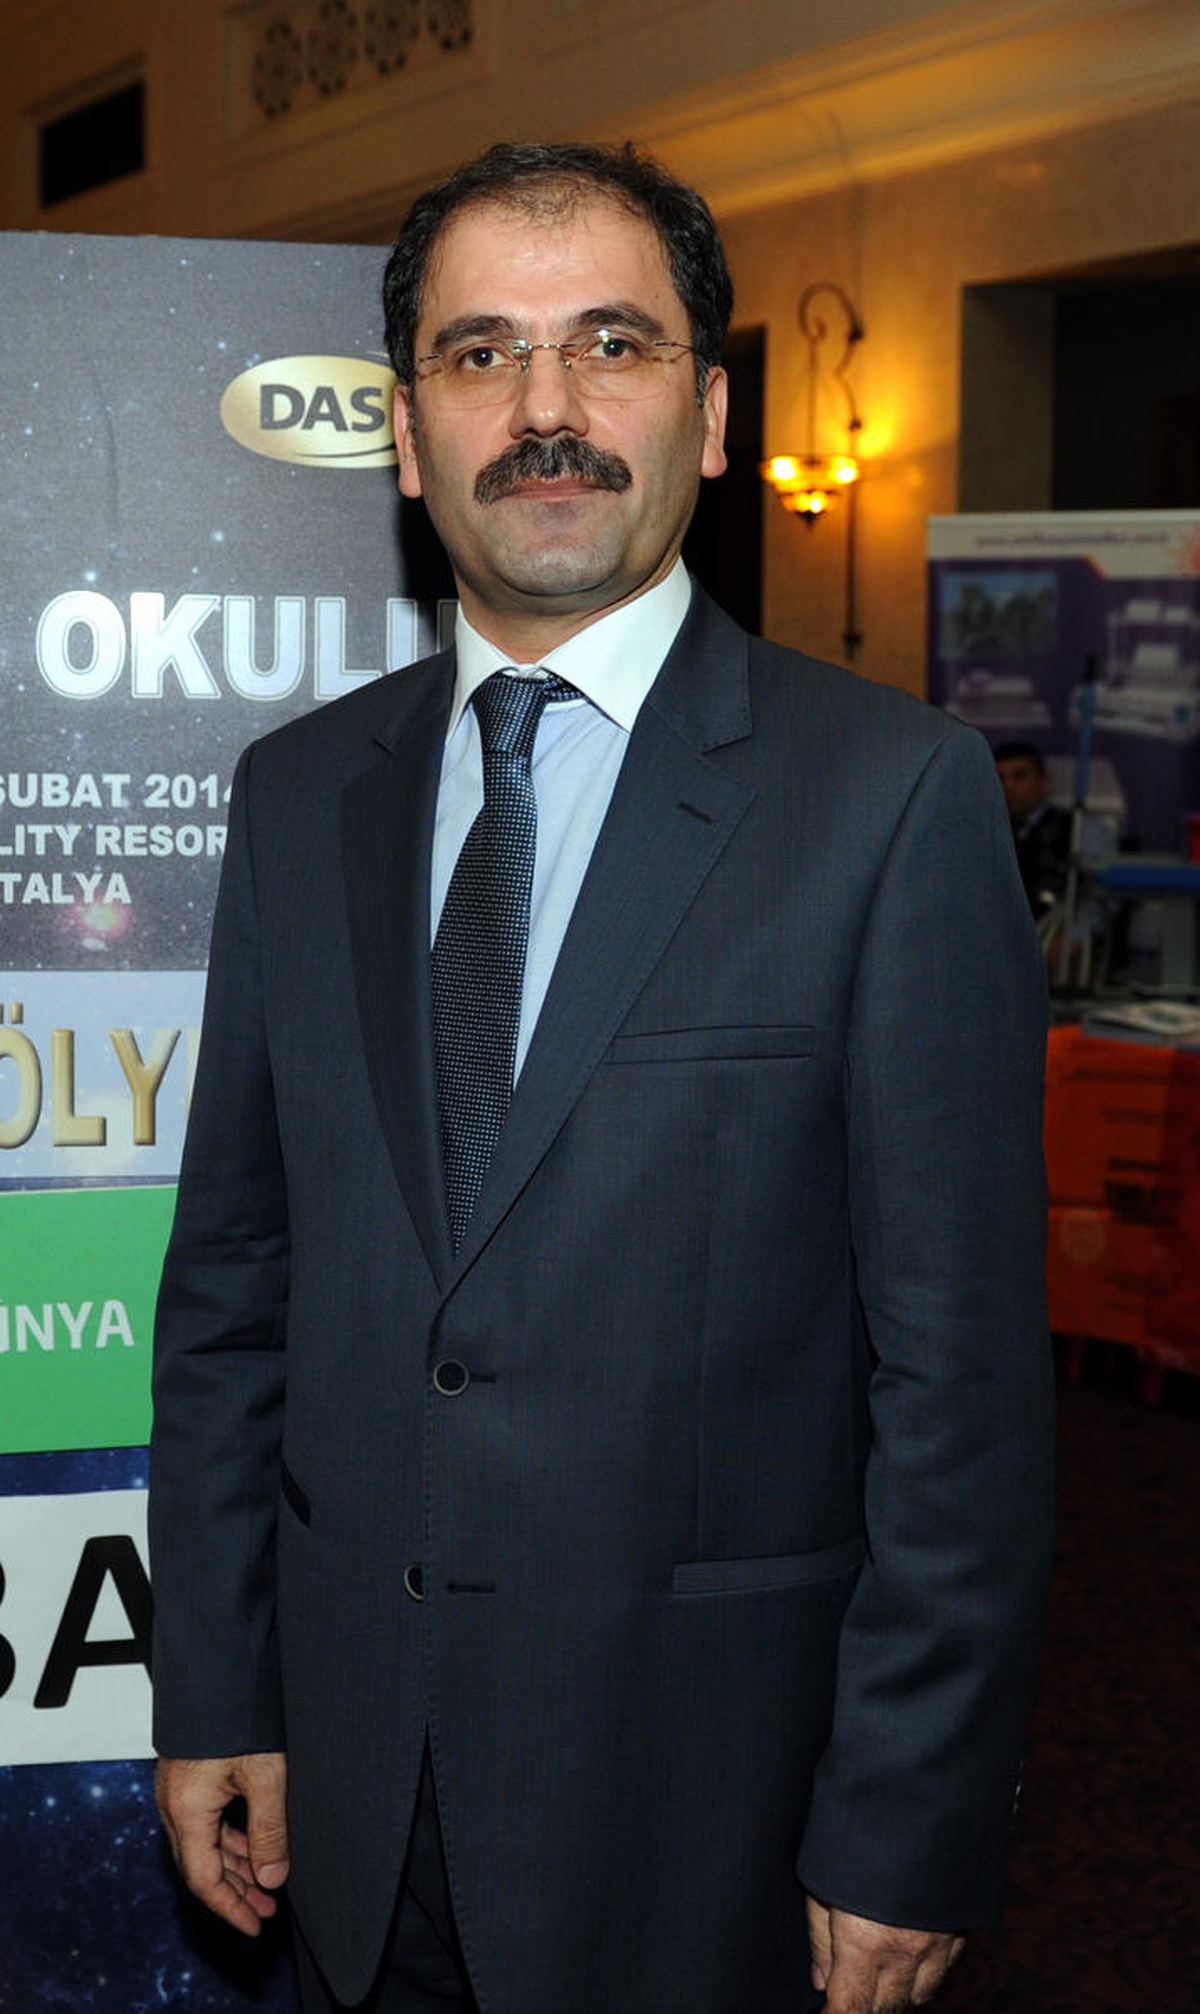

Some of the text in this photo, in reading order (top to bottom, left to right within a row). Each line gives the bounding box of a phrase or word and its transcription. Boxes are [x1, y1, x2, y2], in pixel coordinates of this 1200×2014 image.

[260, 384, 385, 432] DAS
[0, 773, 232, 808] UBAT 201
[0, 1002, 202, 1149] ÖLY
[0, 1300, 135, 1353] NYA
[0, 1535, 155, 1709] A
